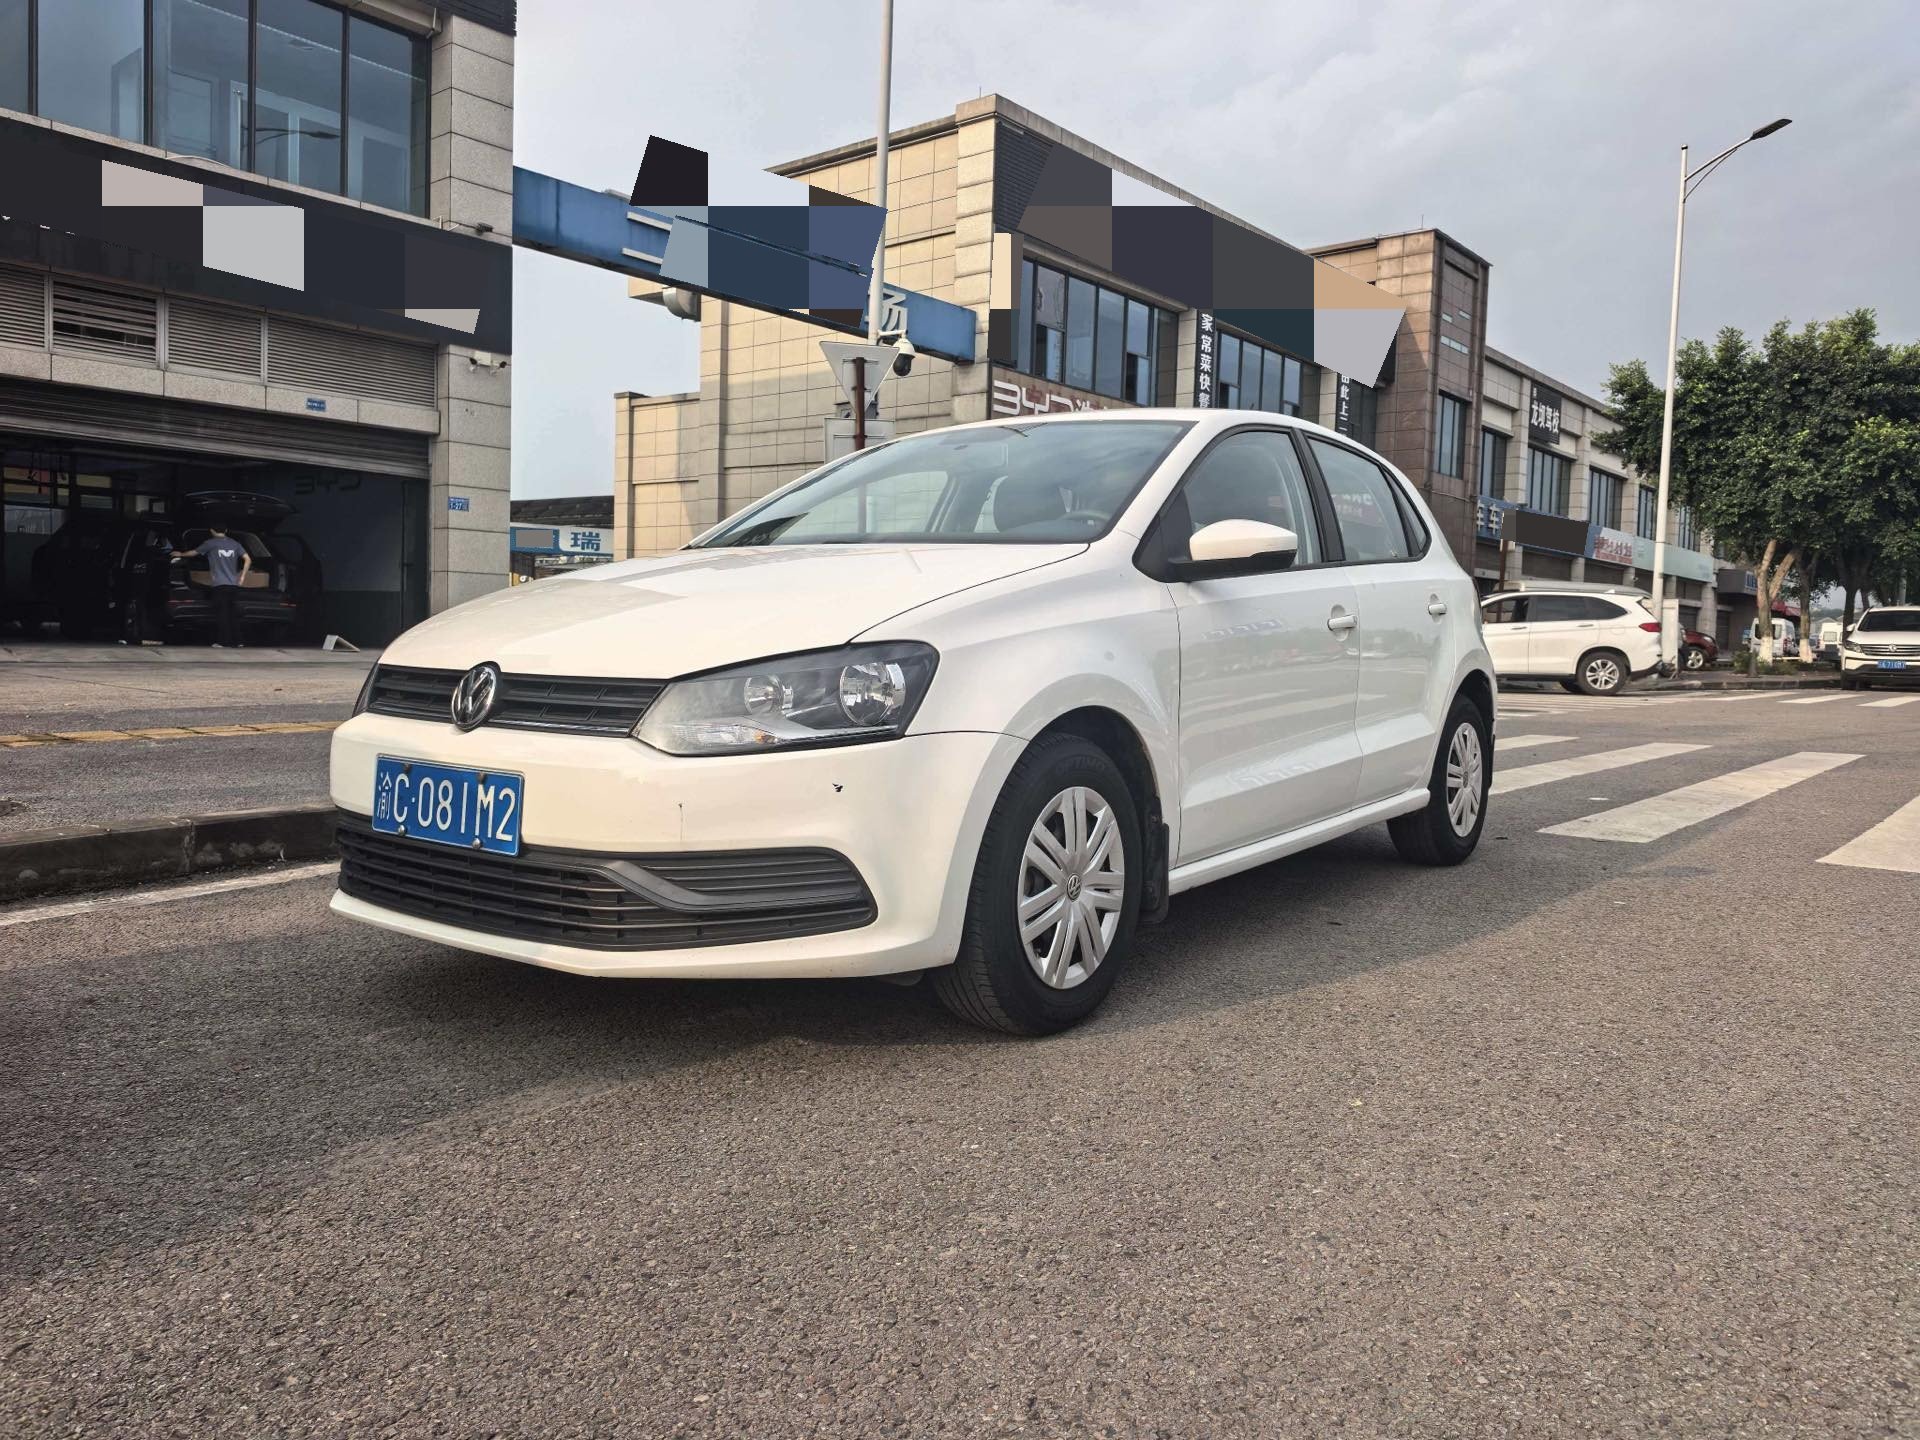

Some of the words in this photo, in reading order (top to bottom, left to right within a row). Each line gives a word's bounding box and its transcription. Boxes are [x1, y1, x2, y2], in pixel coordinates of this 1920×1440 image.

[1199, 313, 1213, 408] 家常菜快餐
[1339, 374, 1350, 431] 由此上二
[570, 531, 601, 551] 瑞
